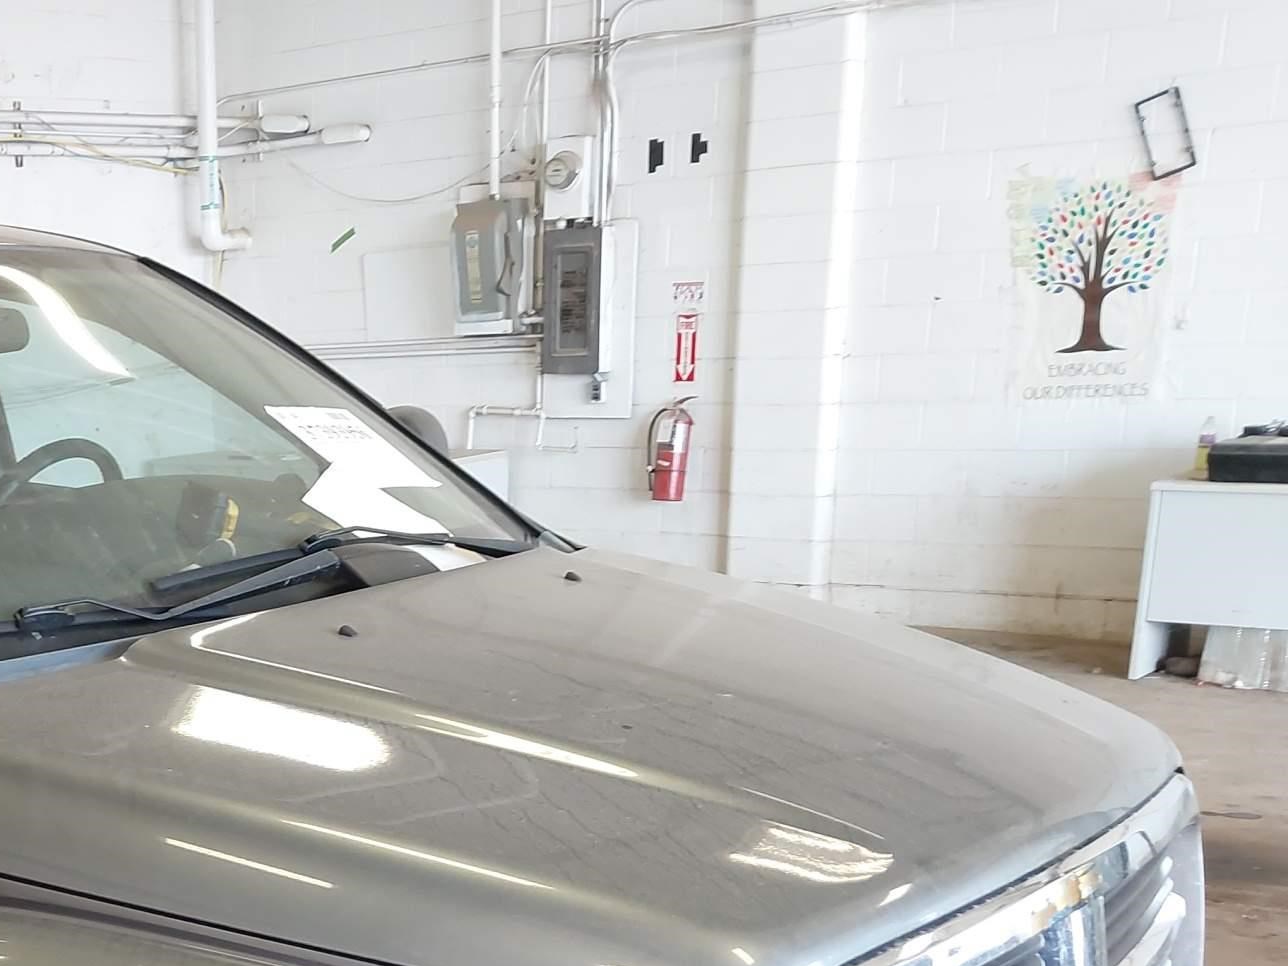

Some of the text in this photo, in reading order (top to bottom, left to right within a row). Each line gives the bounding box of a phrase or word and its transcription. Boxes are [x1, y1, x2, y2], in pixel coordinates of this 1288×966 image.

[1047, 361, 1126, 377] EMBRACING
[1023, 382, 1150, 400] OUR DIFFERENCES
